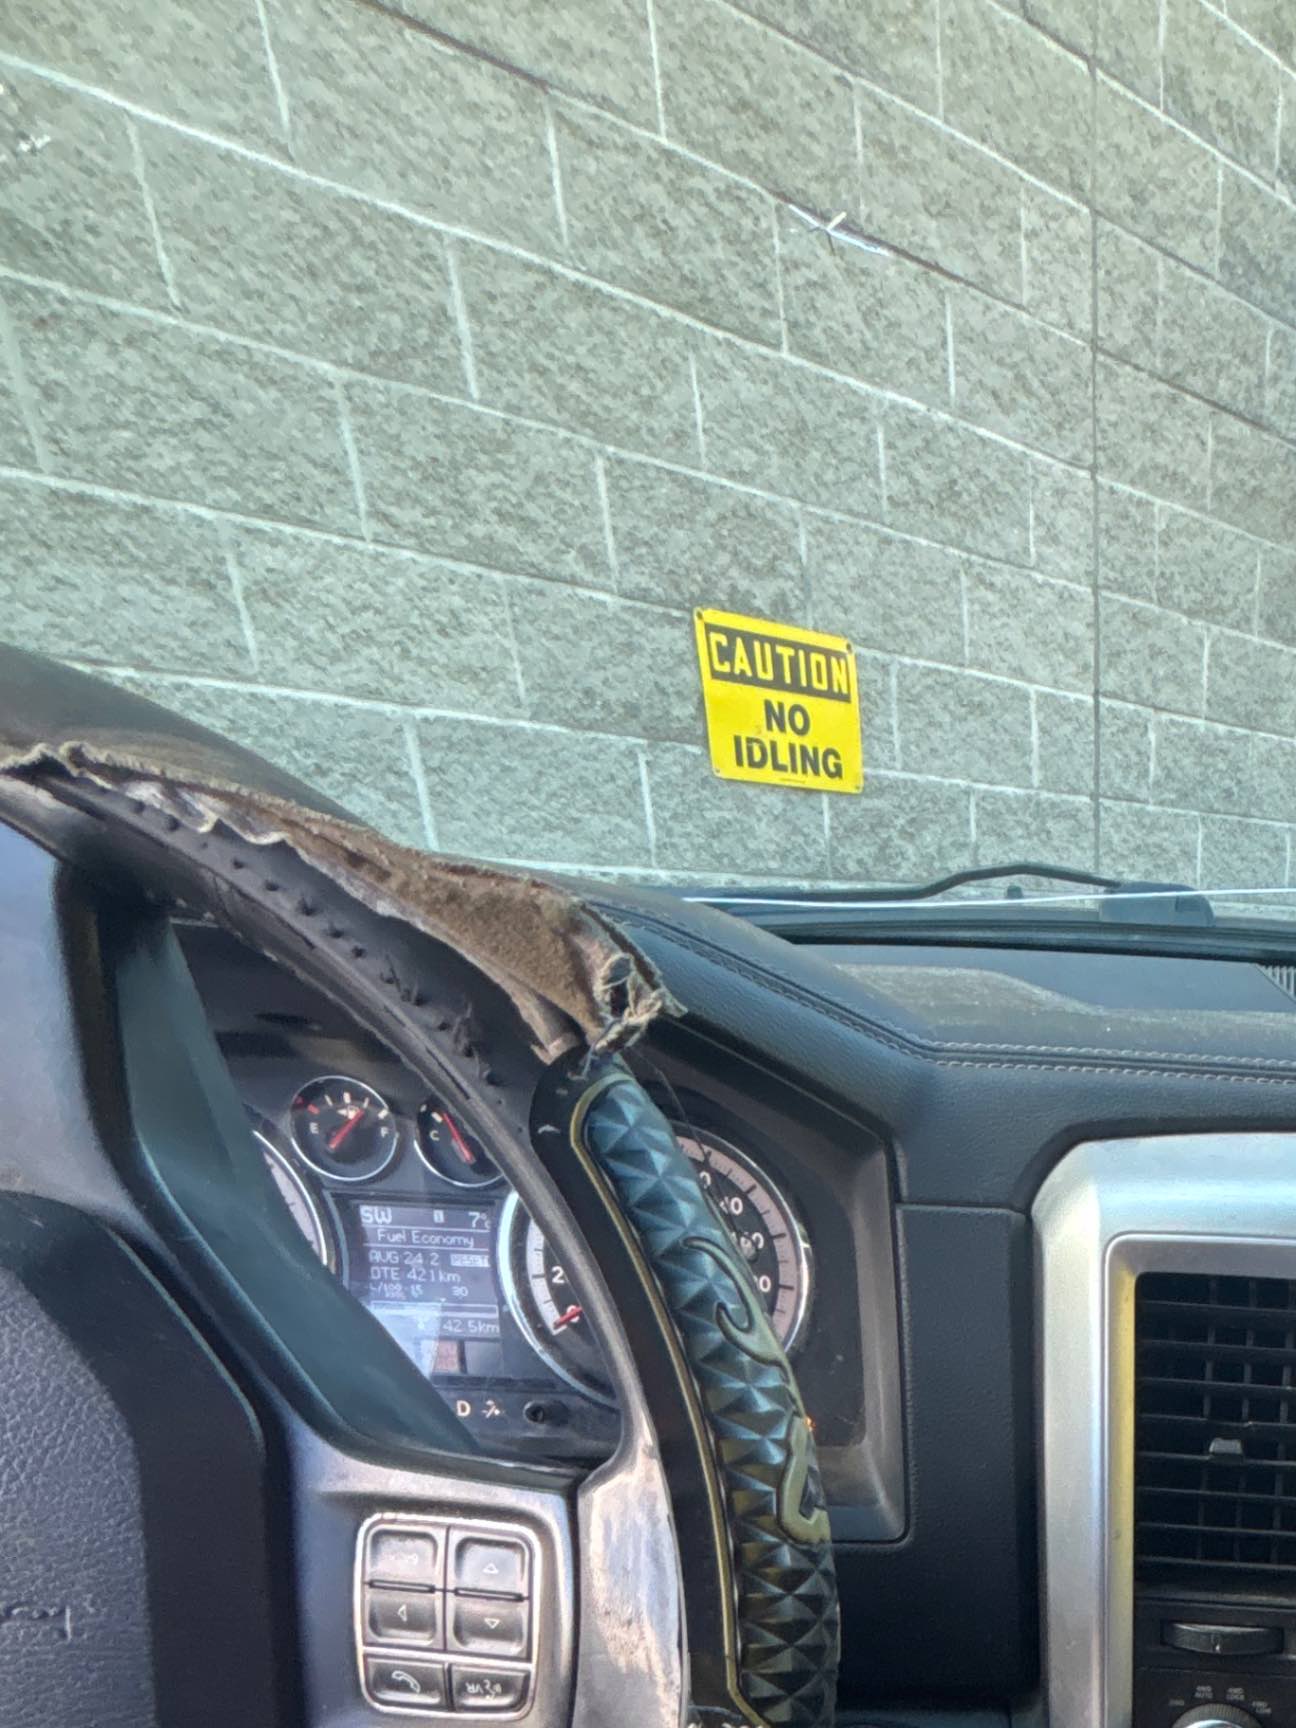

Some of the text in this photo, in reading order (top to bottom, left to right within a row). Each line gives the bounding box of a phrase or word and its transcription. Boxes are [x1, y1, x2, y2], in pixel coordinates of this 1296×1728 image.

[708, 631, 849, 695] CAUTION
[764, 698, 811, 737] NO
[733, 734, 843, 780] IDLING
[309, 1122, 319, 1134] E
[380, 1126, 389, 1138] F
[429, 1130, 440, 1141] C
[360, 1205, 393, 1224] SW
[377, 1229, 475, 1248] Fuel Economy
[369, 1266, 400, 1281] DTE
[456, 1399, 471, 1417] D
